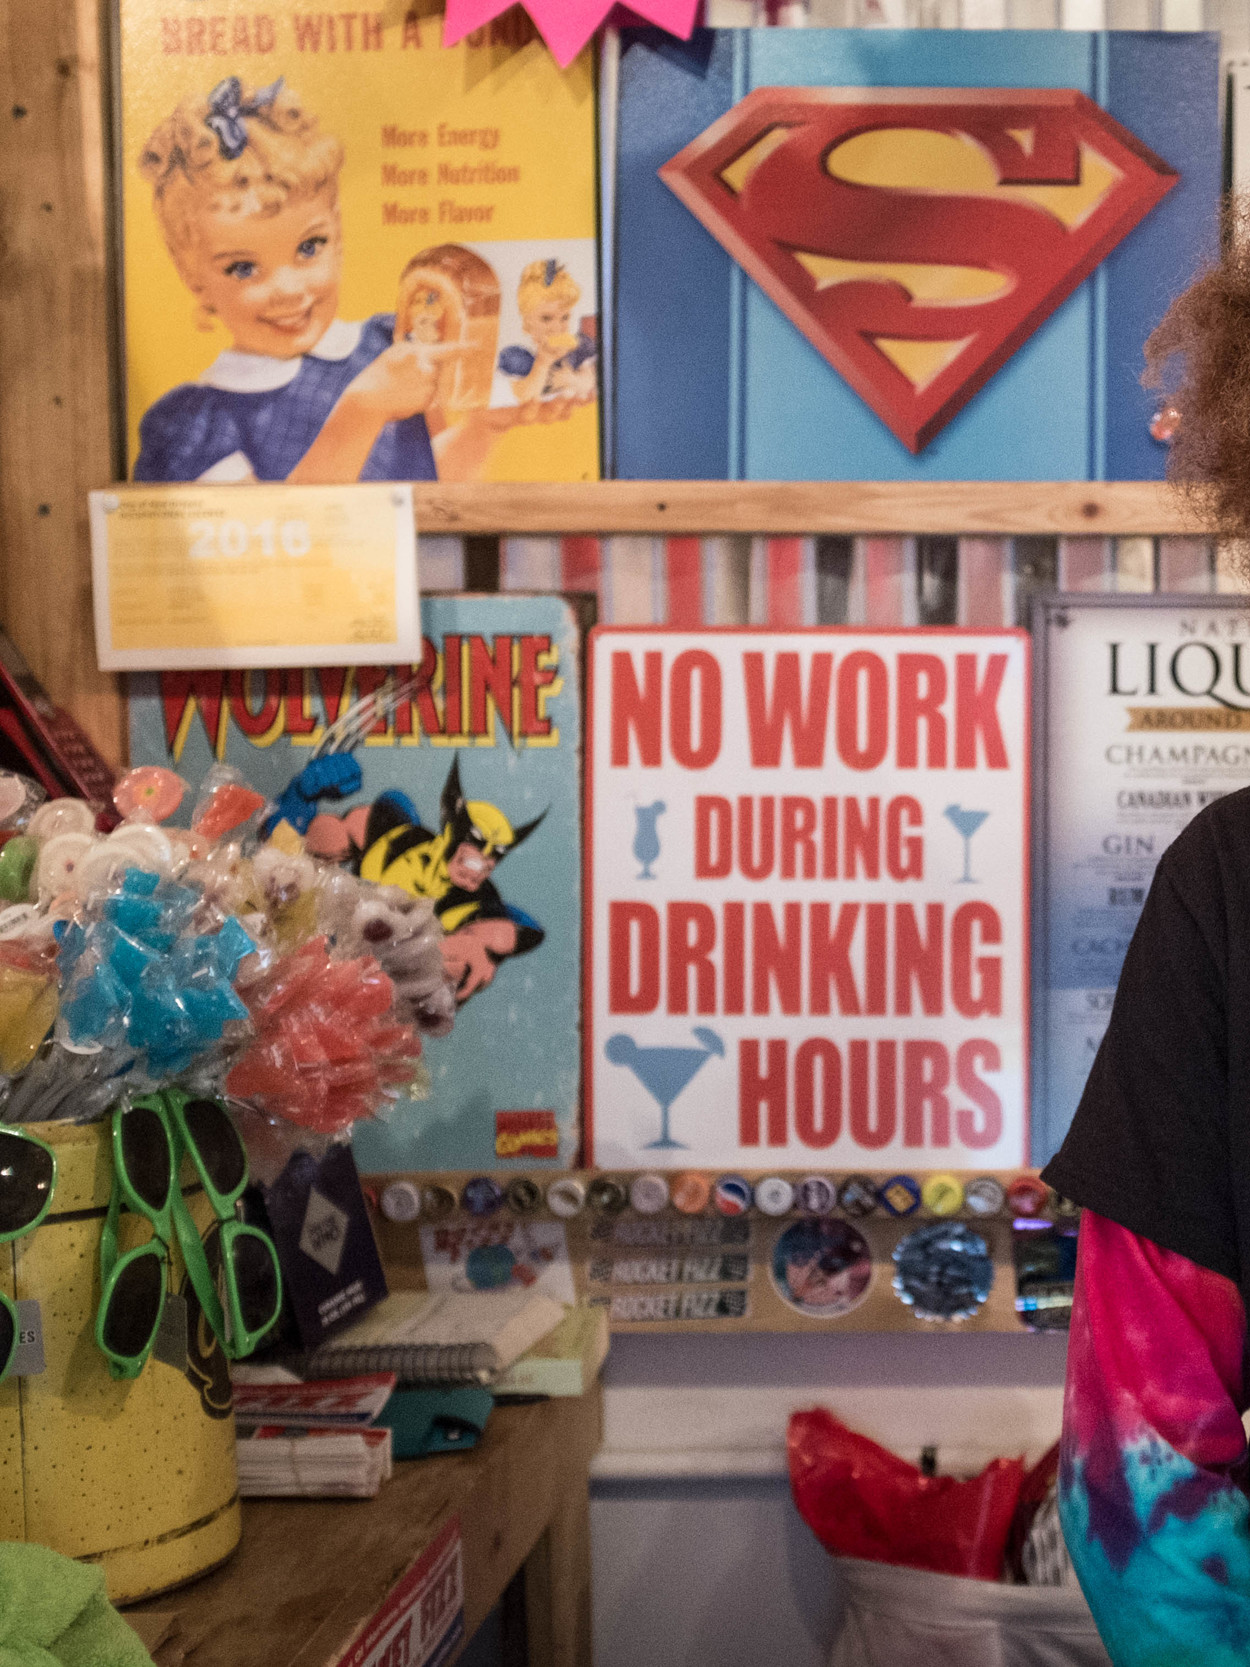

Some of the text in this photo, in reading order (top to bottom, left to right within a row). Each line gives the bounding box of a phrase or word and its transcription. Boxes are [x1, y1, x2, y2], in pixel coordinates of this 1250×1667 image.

[161, 14, 276, 55] BREAD
[293, 12, 383, 52] WITH
[402, 10, 422, 49] A
[382, 122, 499, 151] More Energy
[382, 160, 520, 187] More Nutrition
[382, 200, 494, 225] More Flavor
[610, 648, 1010, 772] NO WORK
[1141, 709, 1243, 729] AROUND
[1117, 789, 1191, 808] CANADIAN
[693, 794, 924, 881] DURING
[1102, 834, 1154, 854] GIN
[608, 900, 1003, 1019] DRINKING
[738, 1036, 1003, 1151] HOURS
